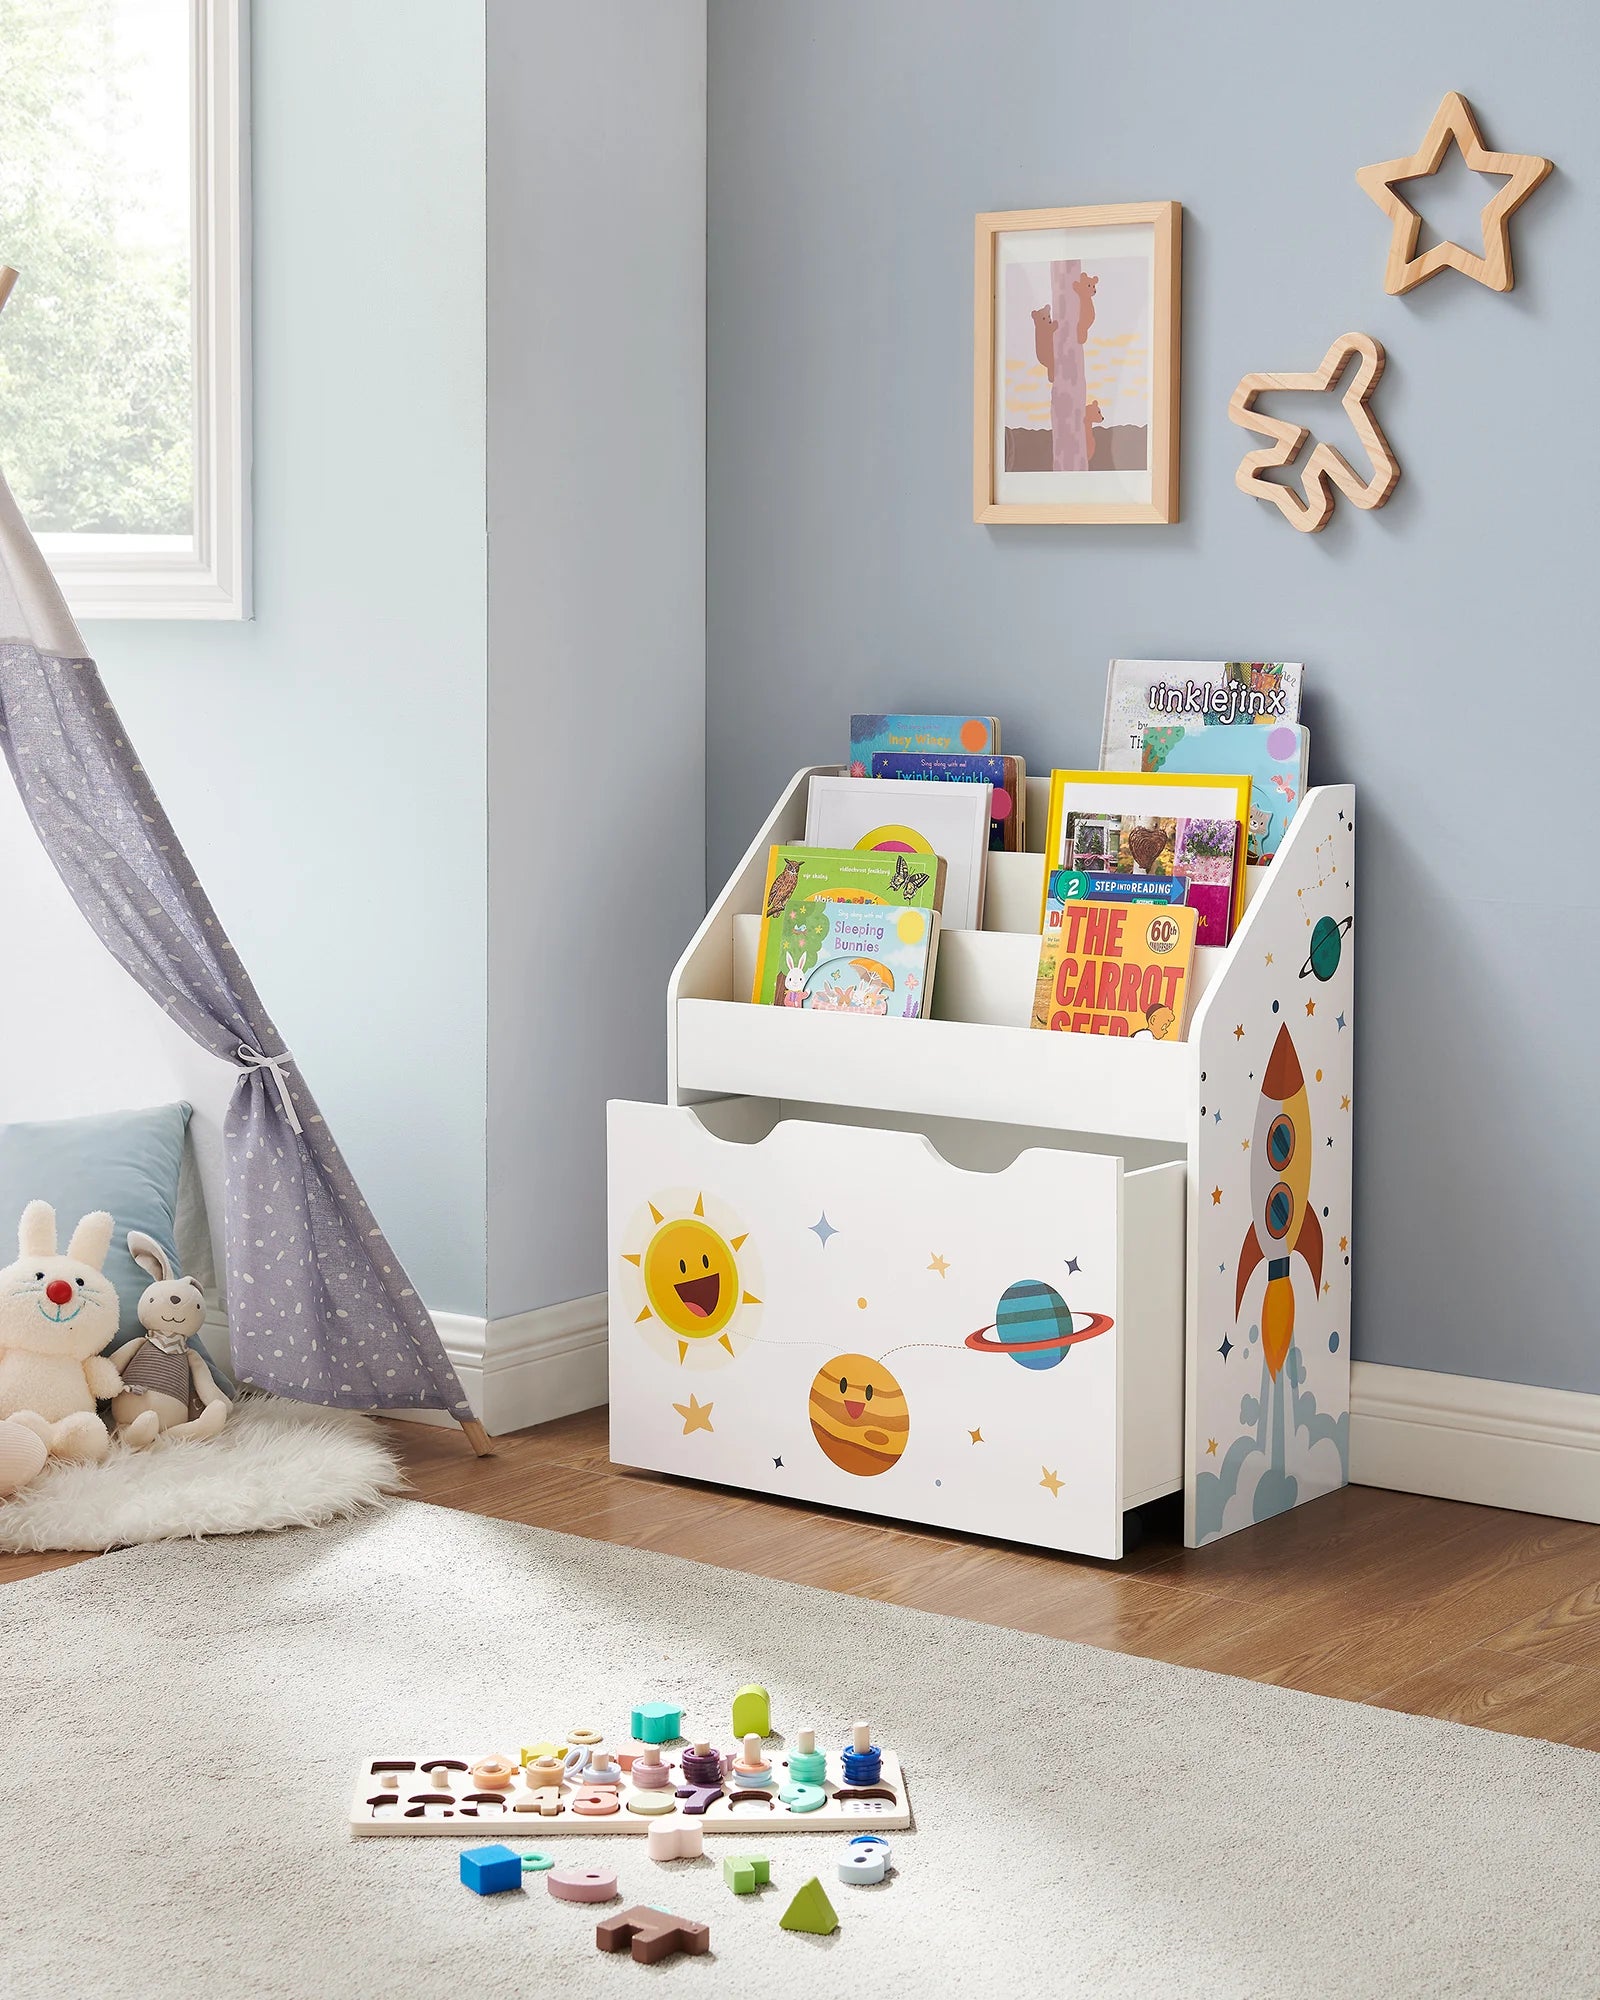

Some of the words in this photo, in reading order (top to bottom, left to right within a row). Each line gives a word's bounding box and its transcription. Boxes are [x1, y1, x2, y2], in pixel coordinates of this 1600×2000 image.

[1067, 878, 1080, 897] 2
[1095, 881, 1116, 892] STEP
[834, 921, 884, 939] Sleeping
[1066, 906, 1128, 957] THE
[1151, 920, 1177, 942] 60th
[834, 937, 880, 952] Bunnies
[1055, 957, 1185, 1014] CARROT
